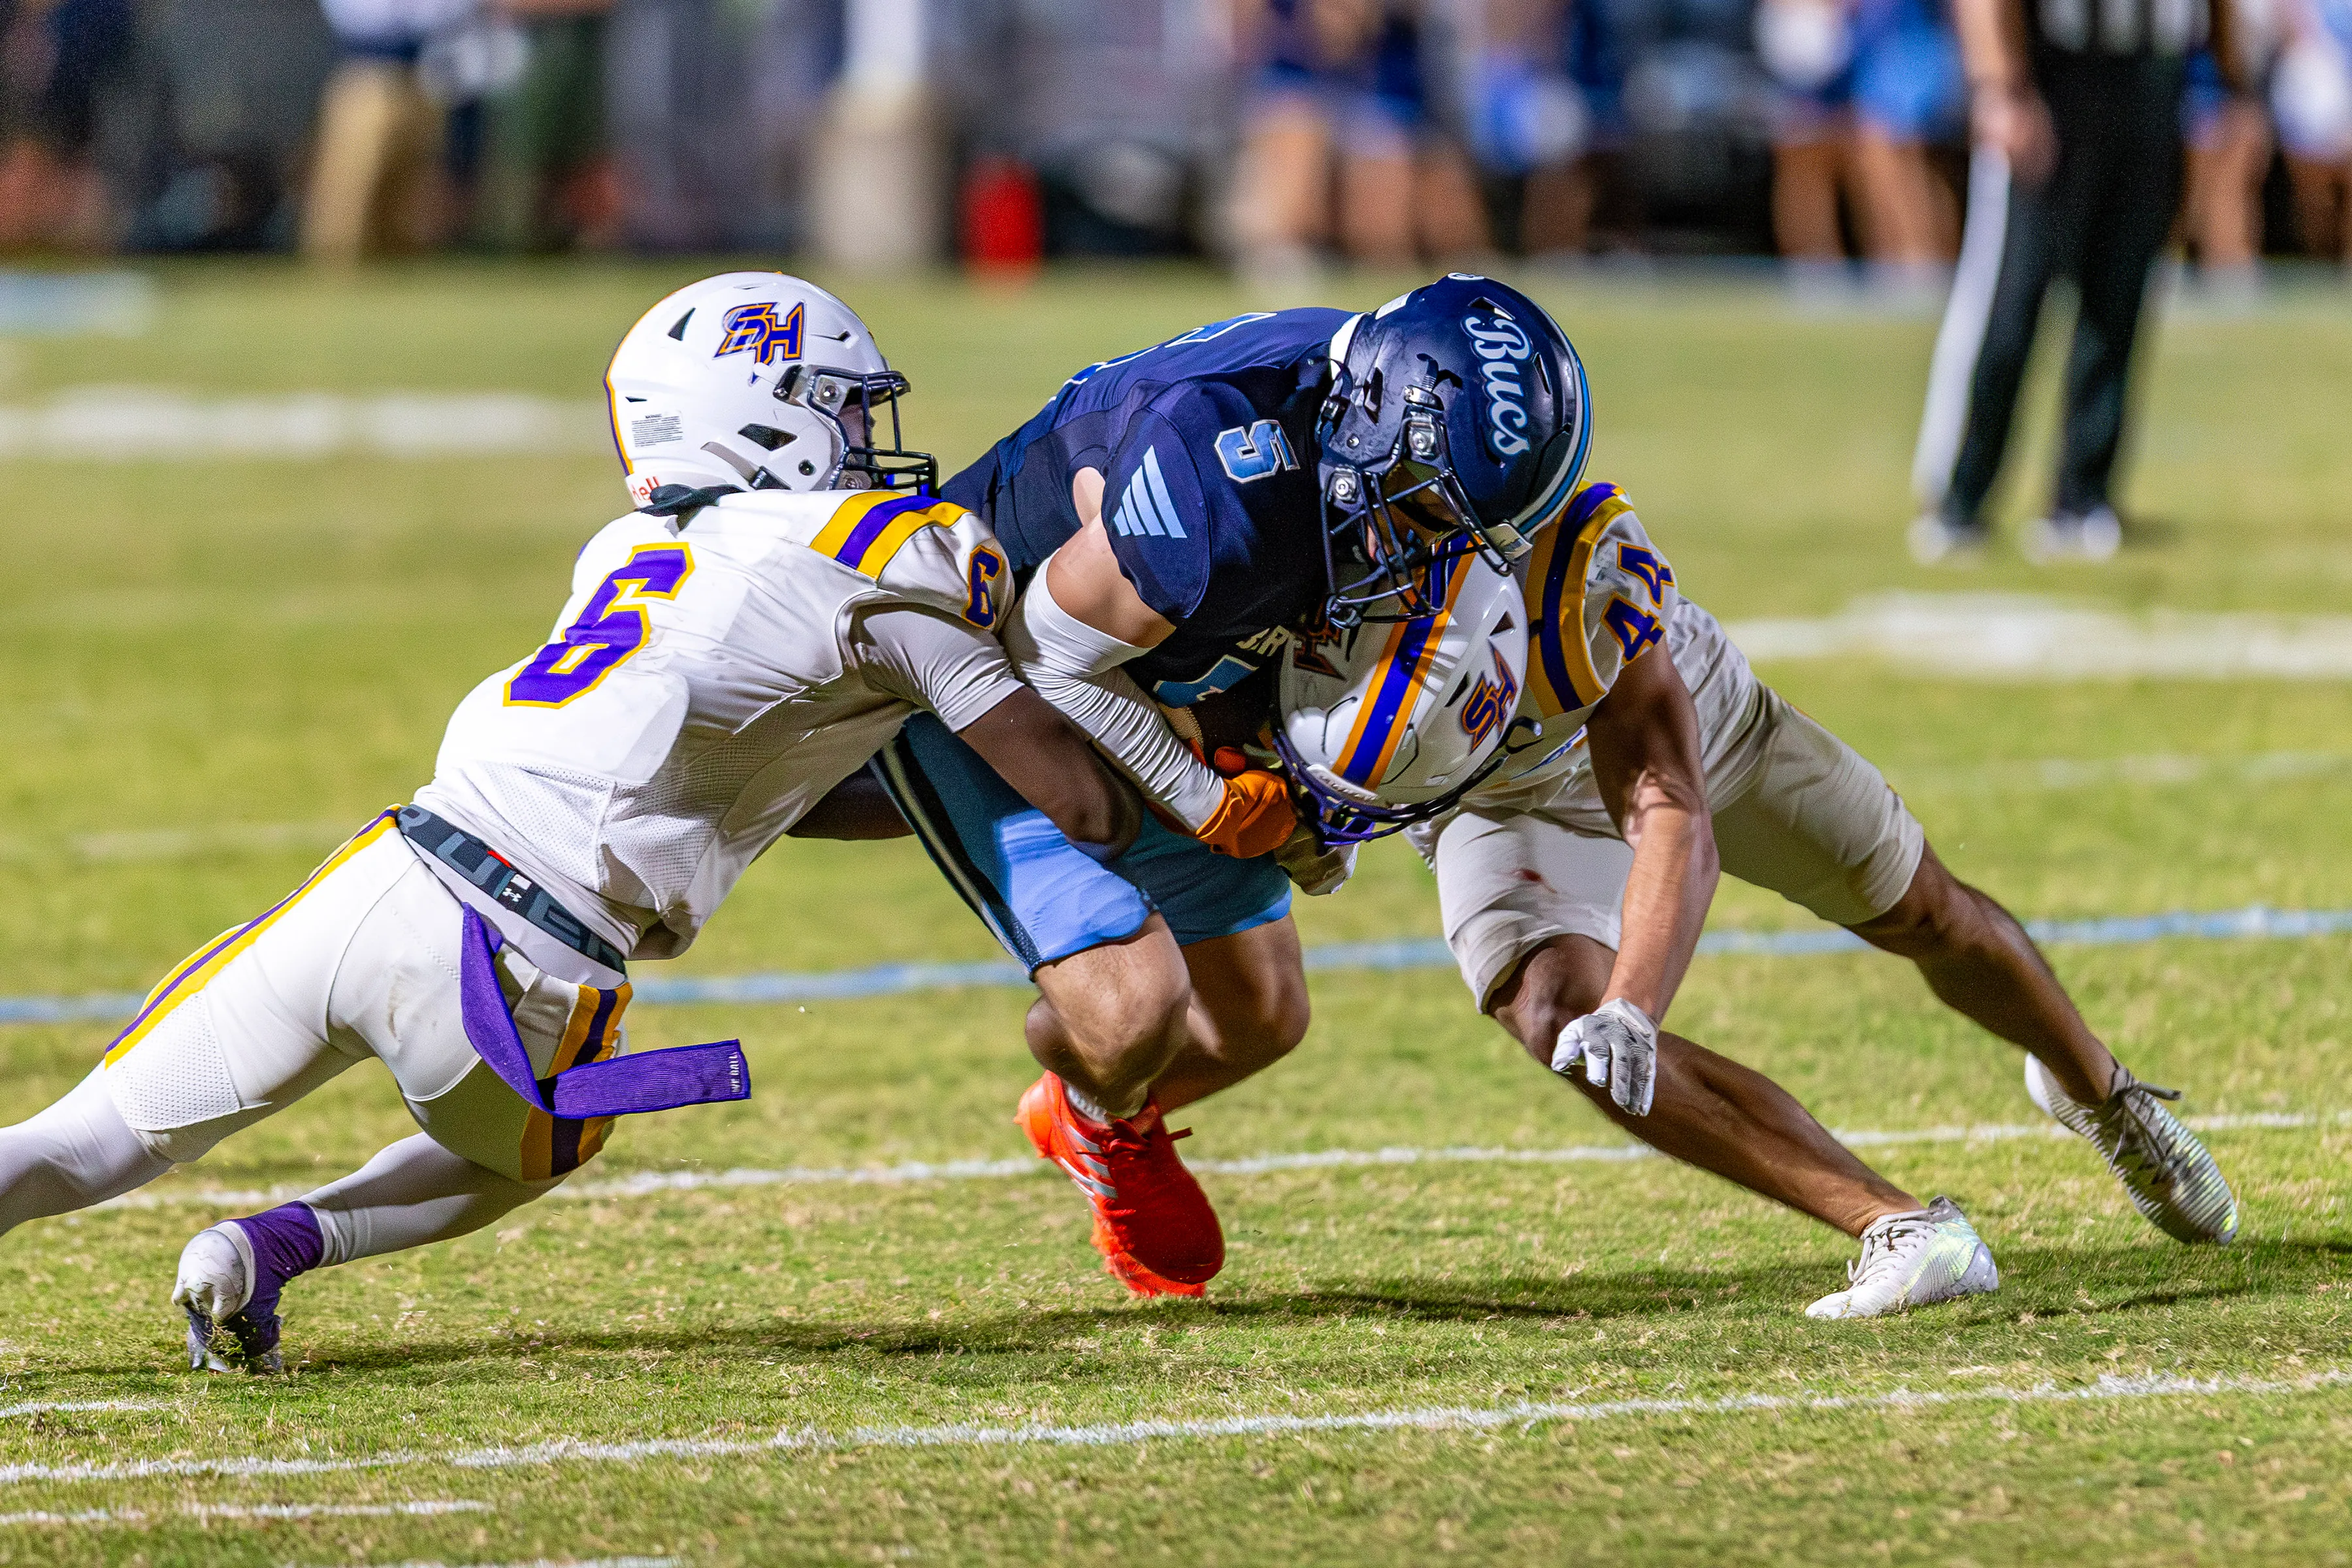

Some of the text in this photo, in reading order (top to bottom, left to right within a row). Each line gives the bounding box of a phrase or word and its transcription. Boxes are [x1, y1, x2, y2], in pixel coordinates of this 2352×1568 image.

[713, 301, 805, 384] SH
[1463, 316, 1531, 456] Bucs
[1214, 419, 1300, 484] 5
[502, 542, 695, 710] 6
[961, 544, 1003, 630] 6
[1600, 542, 1675, 665] 44
[1461, 636, 1517, 756] SH
